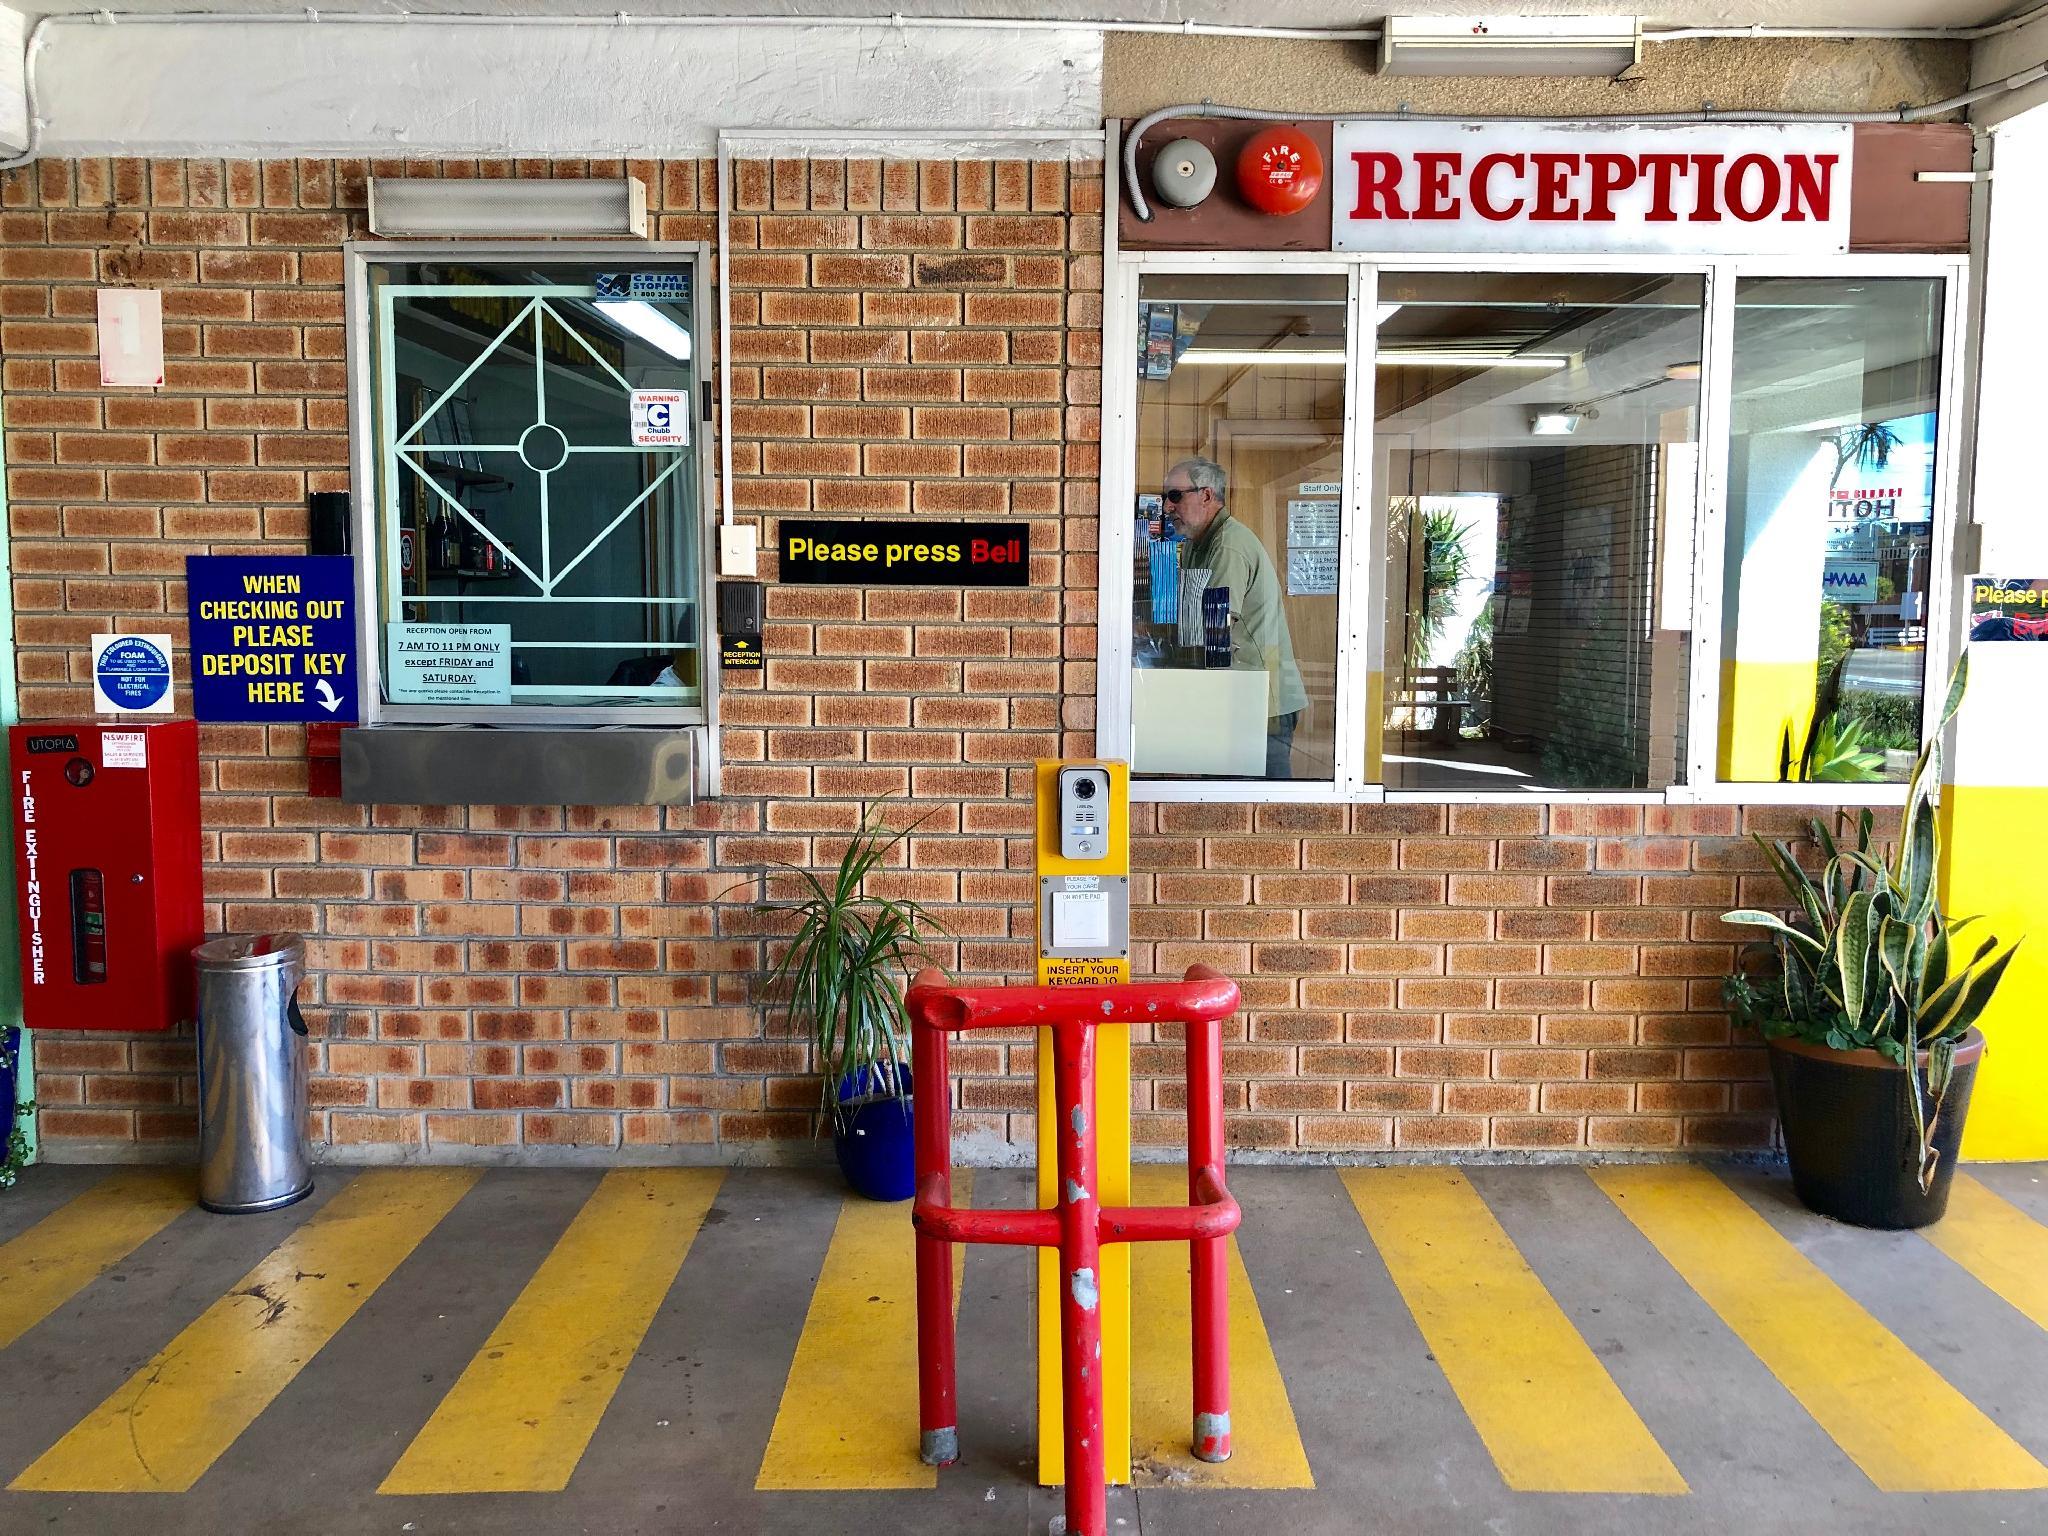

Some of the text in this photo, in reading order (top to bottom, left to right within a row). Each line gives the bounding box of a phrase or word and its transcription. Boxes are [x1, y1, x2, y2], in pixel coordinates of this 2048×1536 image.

[1263, 145, 1300, 164] FIRE
[1349, 151, 1839, 223] RECEPTION
[633, 274, 689, 282] CRIME
[633, 283, 689, 291] STOPPERS
[638, 435, 682, 443] SECURITY
[1324, 484, 1341, 492] Only
[789, 537, 1021, 568] Please press Bell
[243, 575, 301, 594] WHEN
[1975, 585, 2038, 604] Please
[201, 600, 345, 620] CHECKING OUT
[233, 625, 314, 647] PLEASE
[398, 642, 404, 650] 7
[407, 642, 424, 650] AM
[456, 643, 471, 651] PM
[474, 643, 500, 652] ONLY
[120, 651, 145, 659] FOAM
[202, 653, 346, 675] DEPOSIT KEY
[405, 658, 494, 667] except FRIDAY and
[422, 674, 476, 682] SATURDAY.
[125, 689, 142, 697] FIRES
[248, 682, 304, 703] HERE
[31, 738, 75, 751] UTOPIA
[22, 770, 36, 823] FIRE
[25, 829, 45, 985] EXTINGUISHER
[1047, 966, 1119, 975] INSERT YOUR
[1048, 976, 1099, 986] KEYCARD
